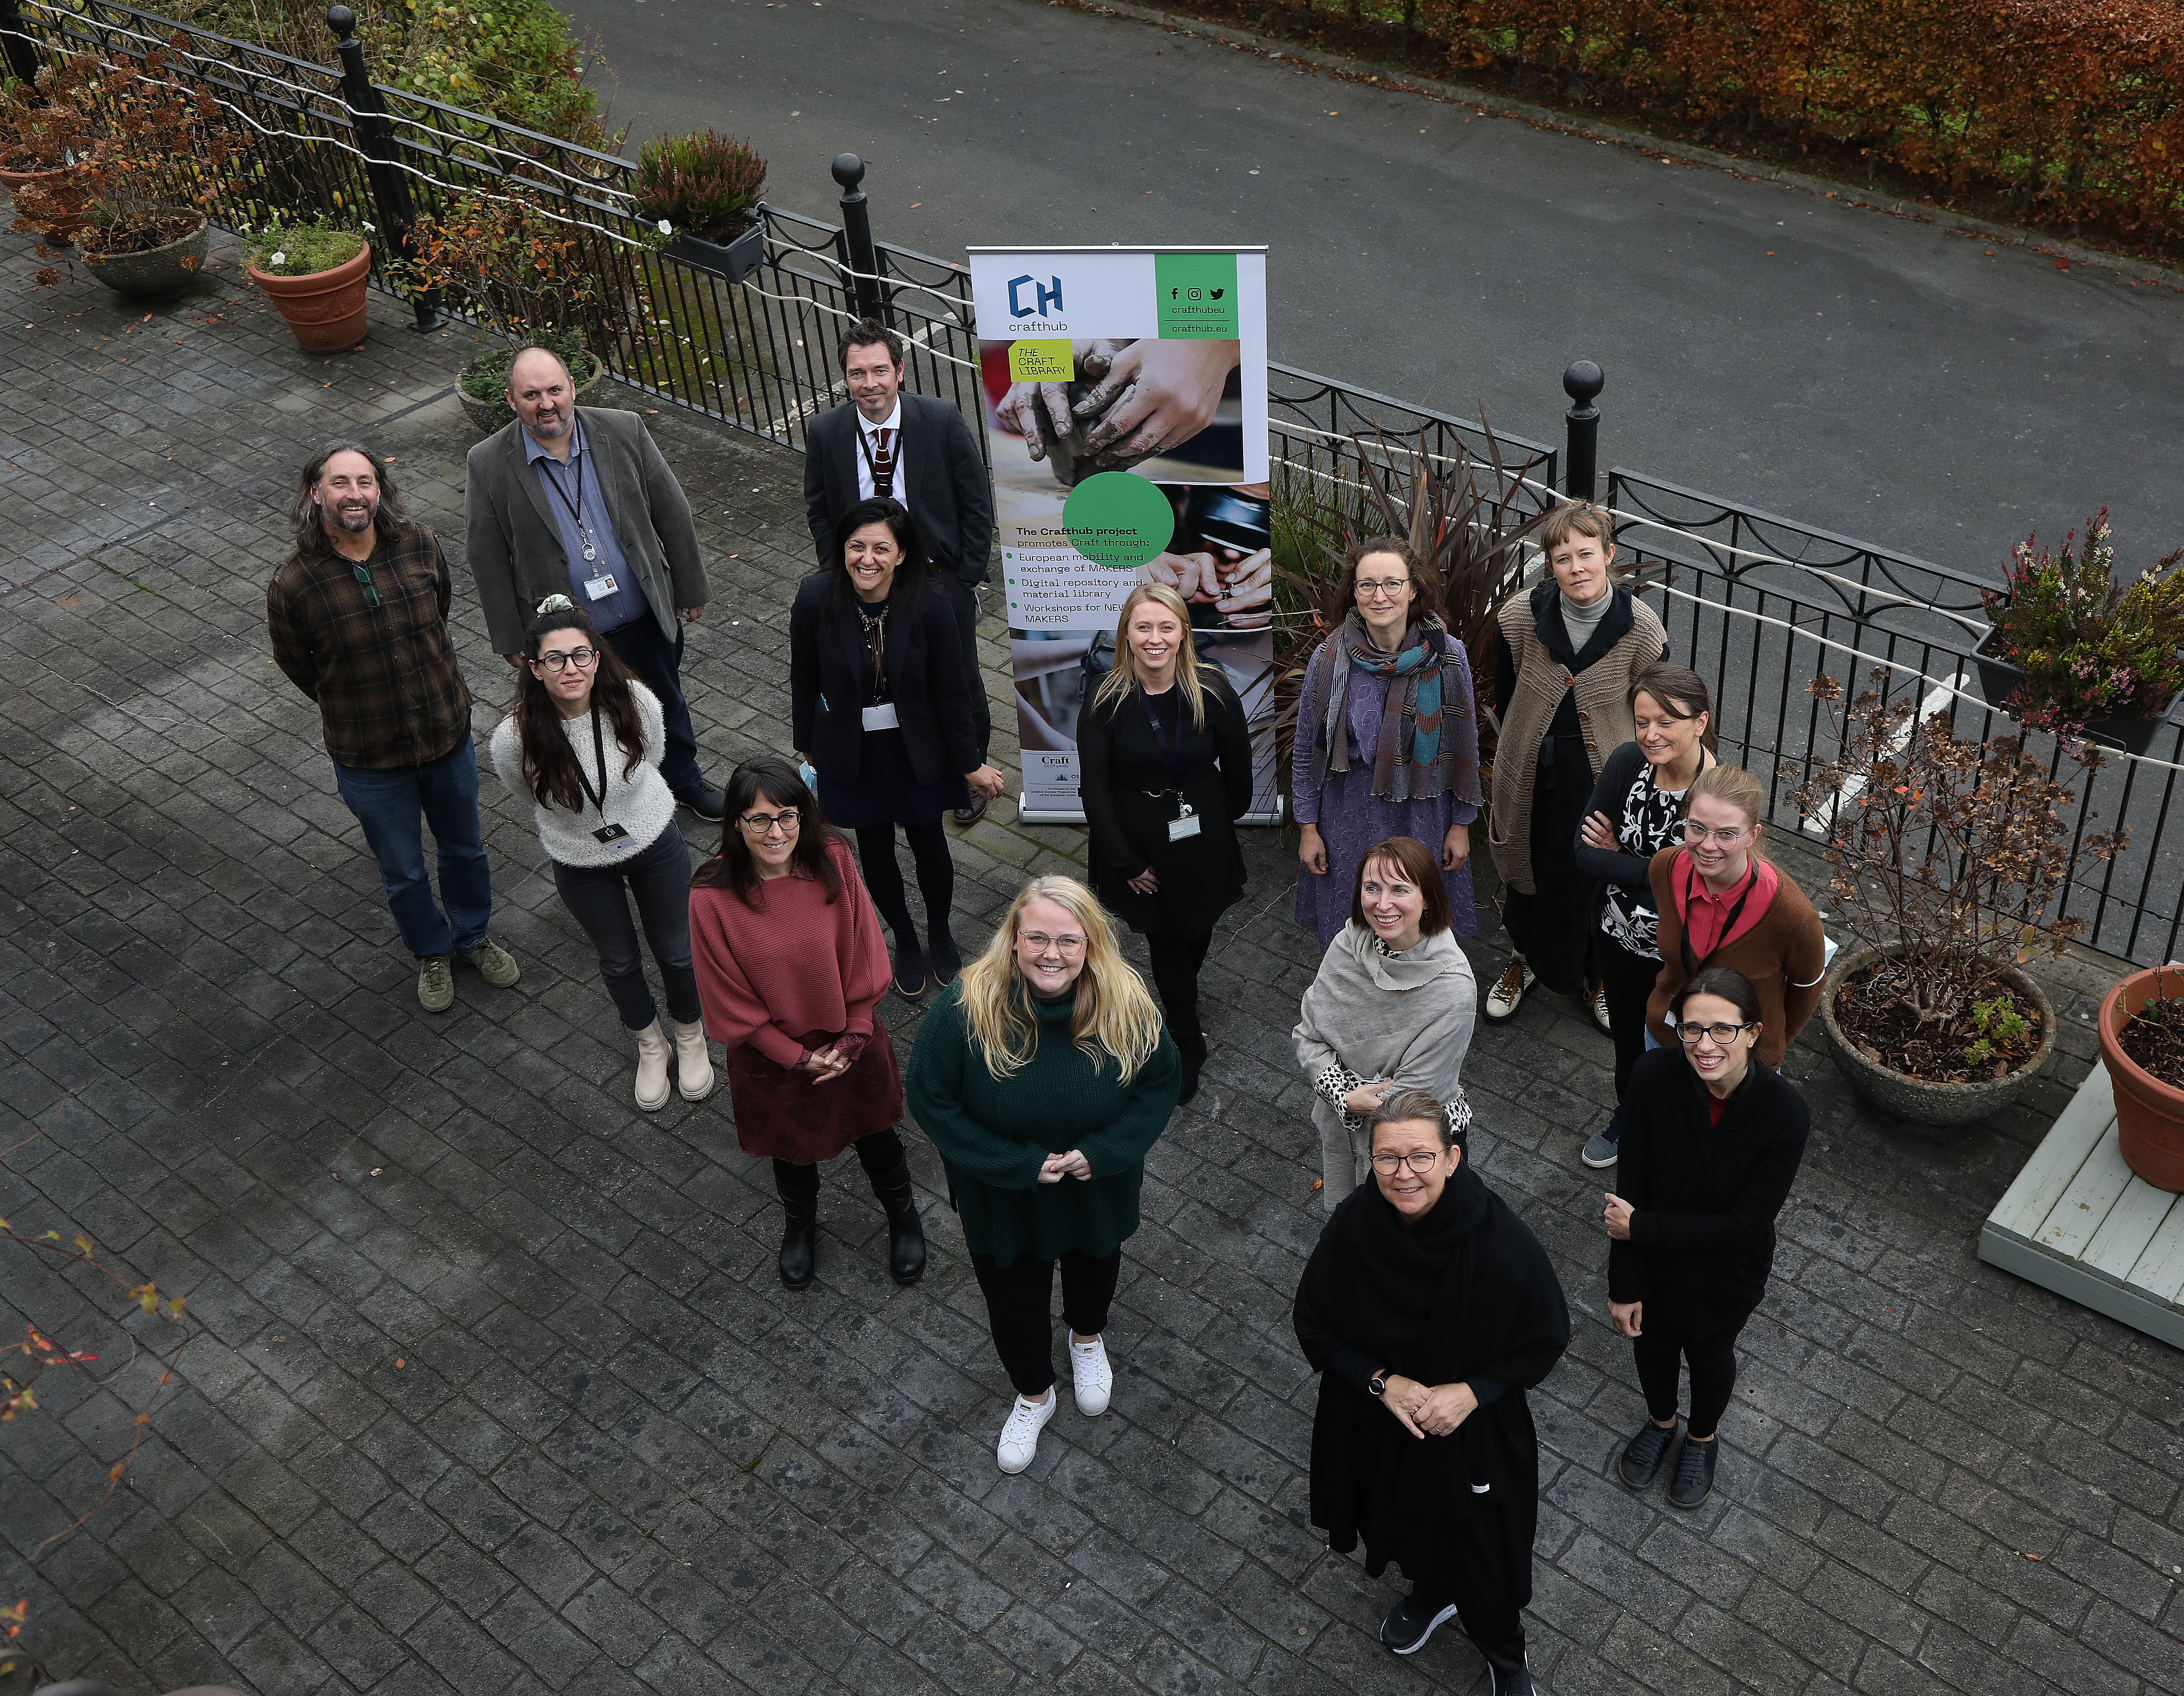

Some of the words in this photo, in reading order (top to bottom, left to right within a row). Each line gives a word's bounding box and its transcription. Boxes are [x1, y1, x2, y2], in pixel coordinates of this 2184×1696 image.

[1008, 275, 1063, 318] CH
[1009, 321, 1067, 332] crafthub
[1018, 357, 1055, 366] CRAFT
[1019, 366, 1065, 375] LIBRARY
[1016, 527, 1037, 536] The
[1040, 527, 1093, 536] Crafthub
[1096, 528, 1137, 537] project
[1104, 539, 1149, 548] through:
[1019, 553, 1068, 562] European
[1072, 553, 1120, 562] mobility
[1020, 565, 1070, 574] exchange
[1022, 579, 1060, 588] Digital
[1064, 579, 1119, 588] repository
[1073, 590, 1111, 598] library
[1024, 604, 1082, 613] Workshops
